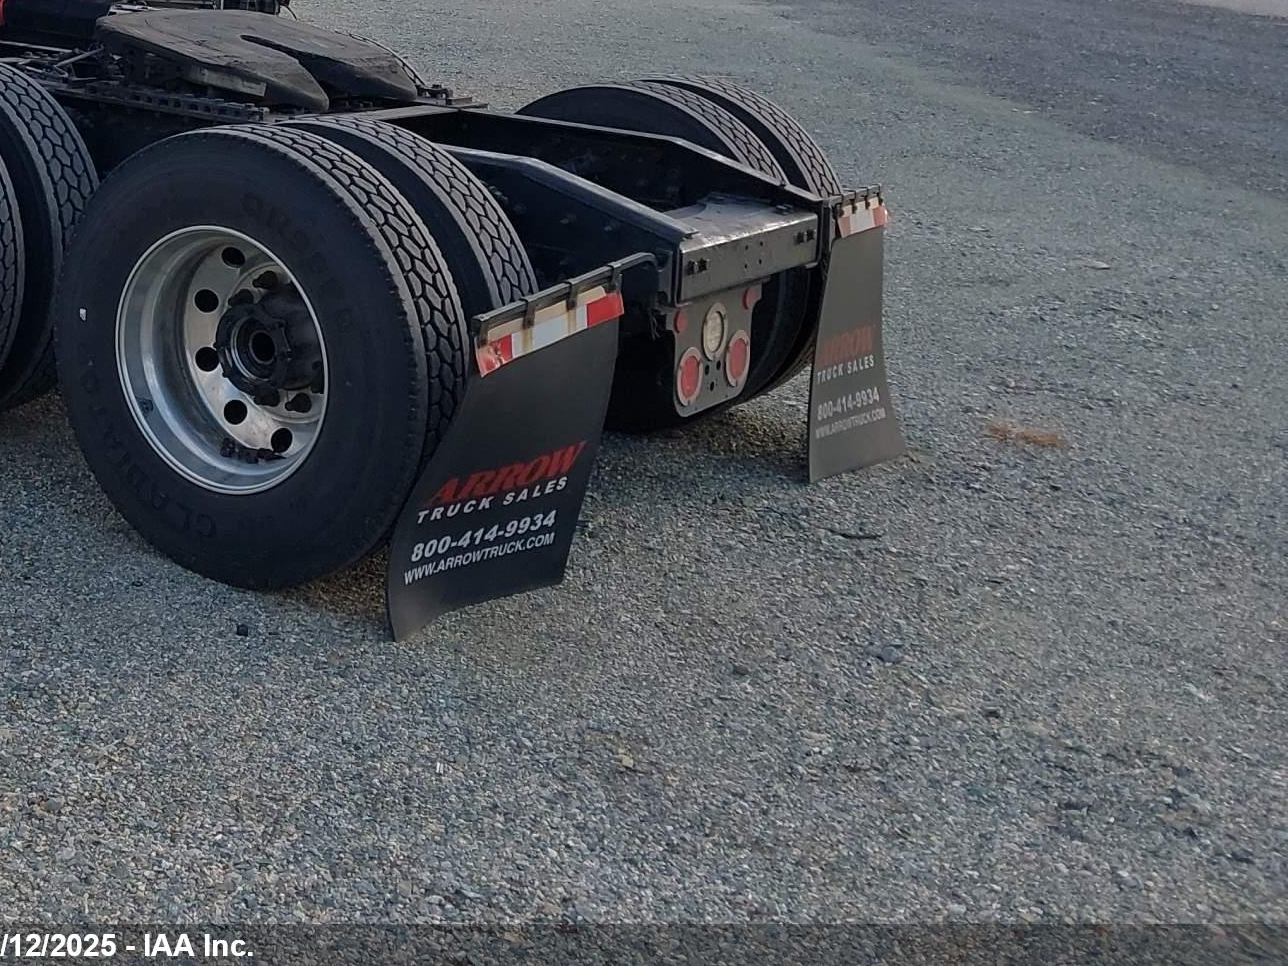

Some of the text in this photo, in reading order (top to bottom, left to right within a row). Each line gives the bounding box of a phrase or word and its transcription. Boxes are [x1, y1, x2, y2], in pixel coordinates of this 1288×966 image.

[817, 354, 875, 385] TRUCK SALES
[817, 386, 880, 421] 800-414-9934
[424, 441, 587, 506] ARROW
[417, 476, 569, 525] TRUCK SALES
[403, 532, 556, 586] WWW.ARROWTRUCK.COM
[410, 509, 558, 563] 800-414-9934
